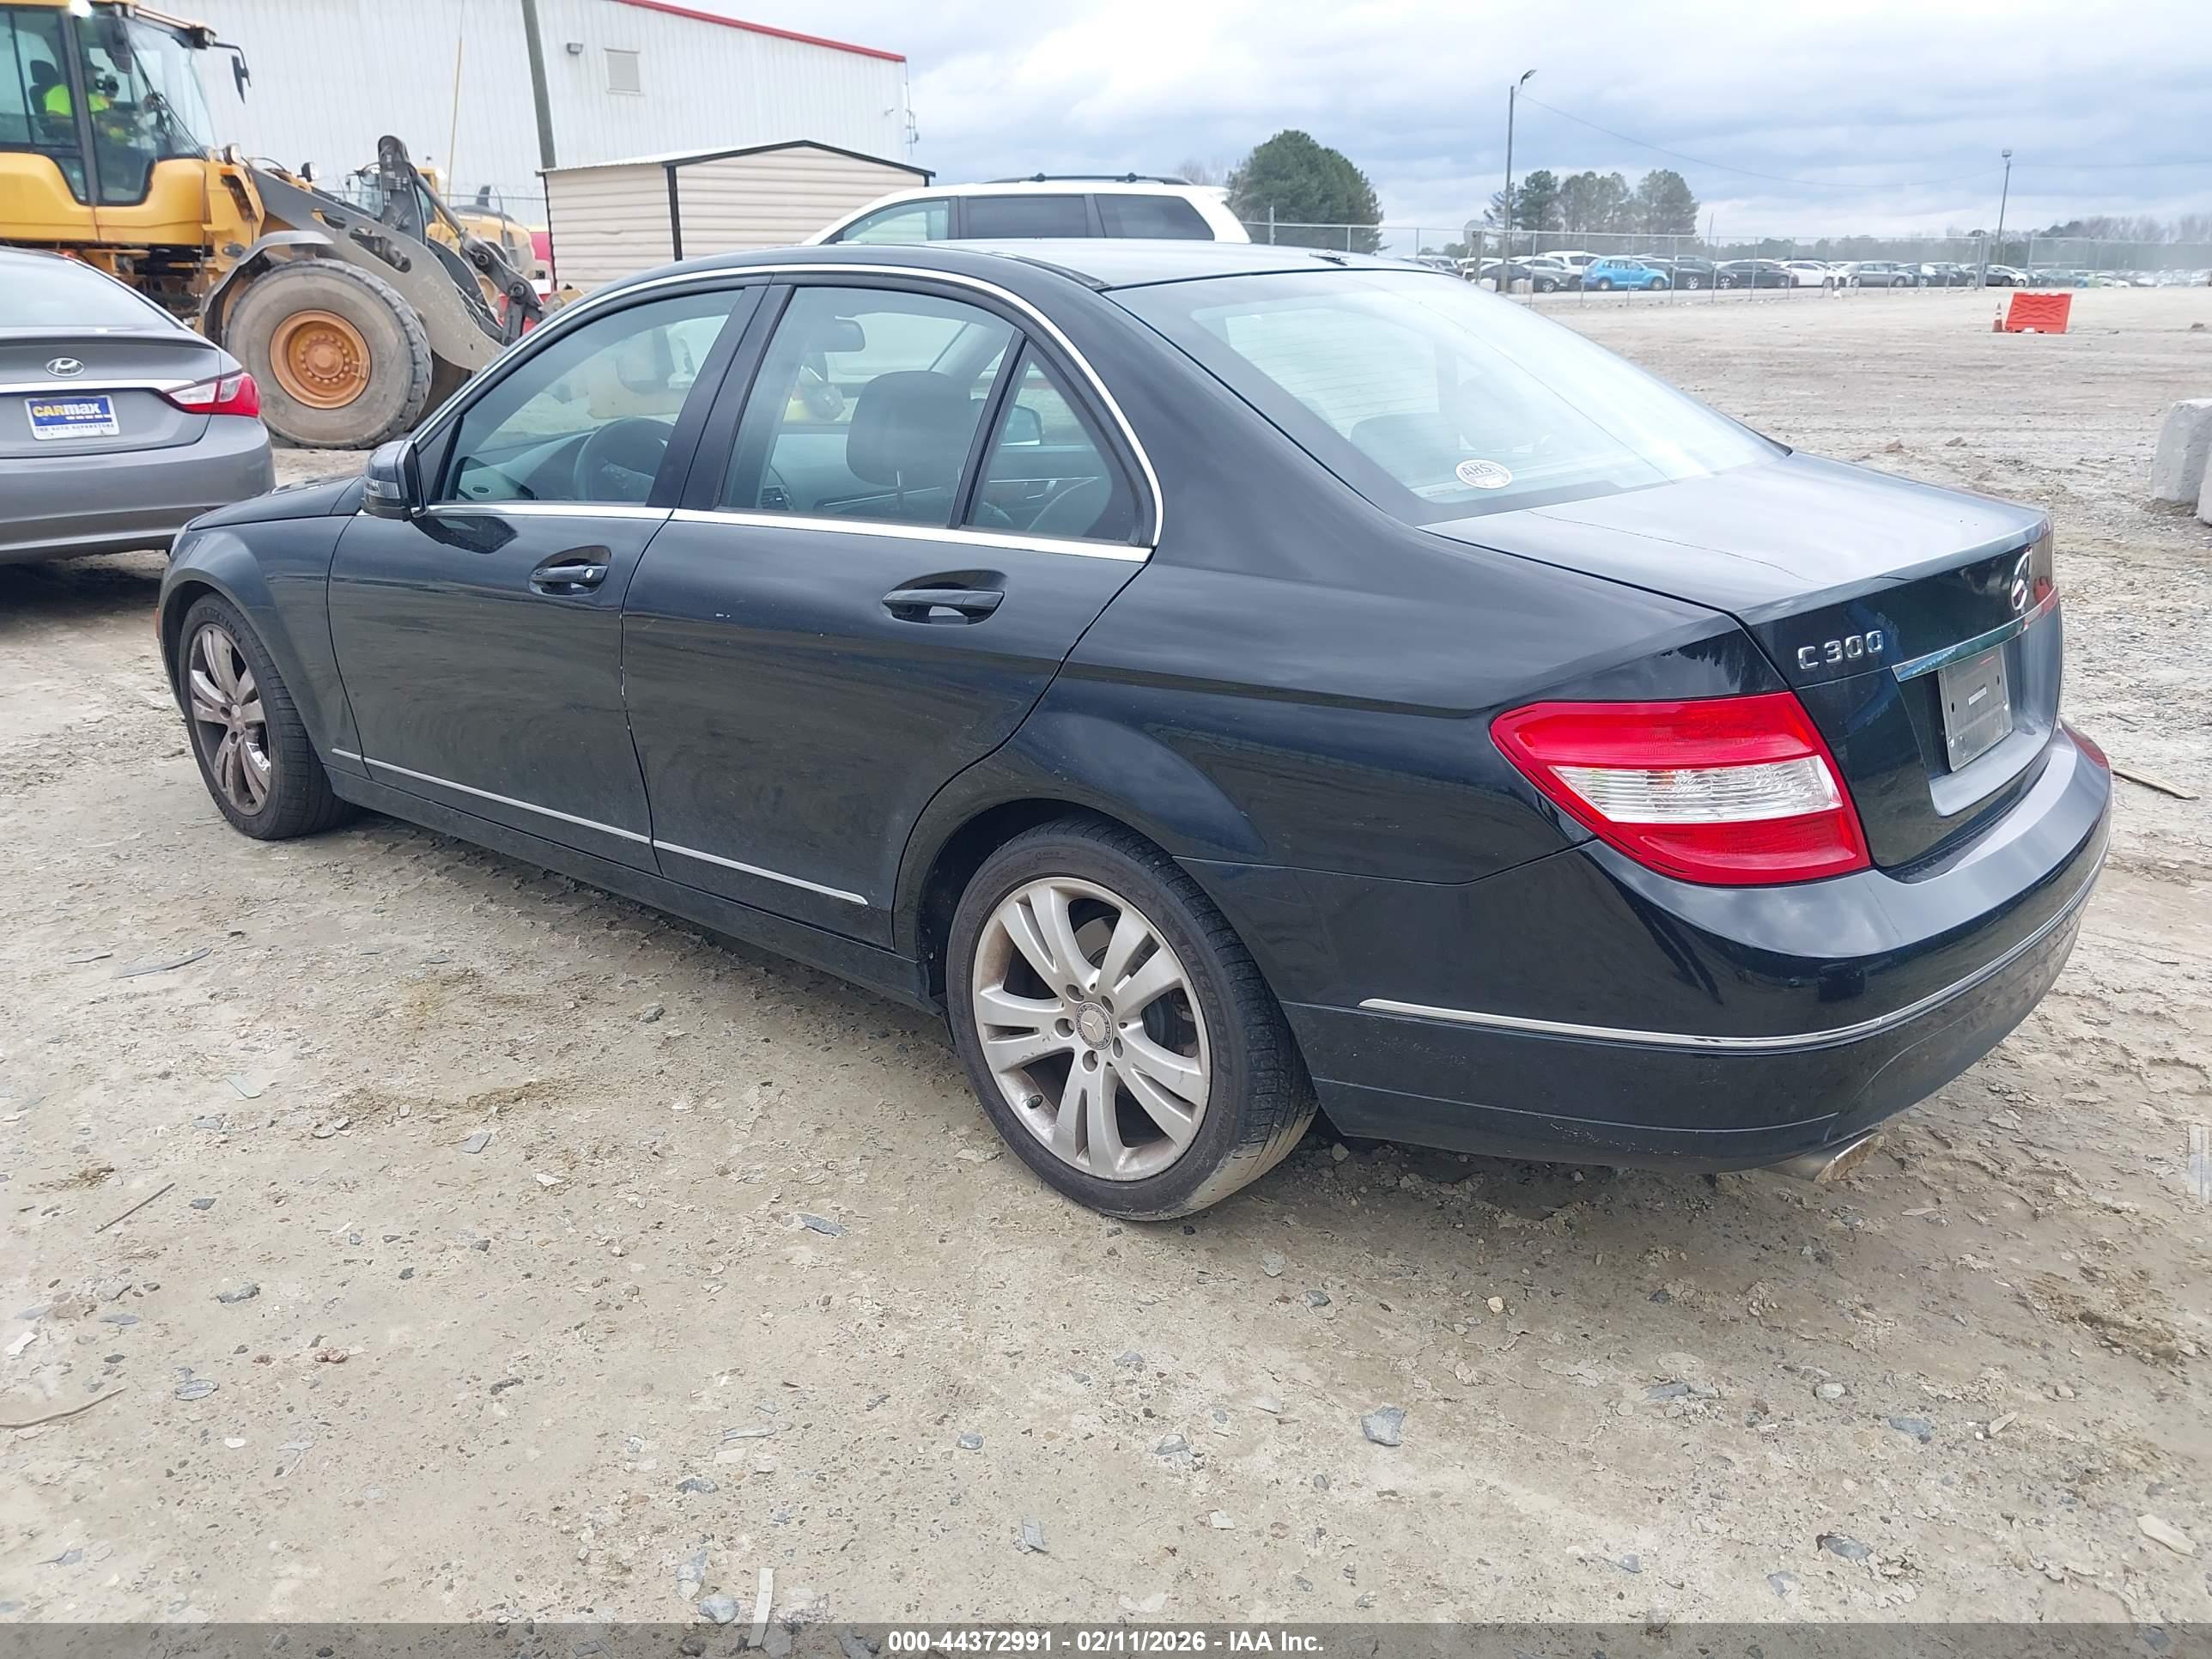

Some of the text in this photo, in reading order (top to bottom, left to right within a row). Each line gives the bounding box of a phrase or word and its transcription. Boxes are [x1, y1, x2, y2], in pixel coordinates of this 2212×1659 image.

[1462, 463, 1492, 477] AHS
[1798, 630, 1884, 670] C 300
